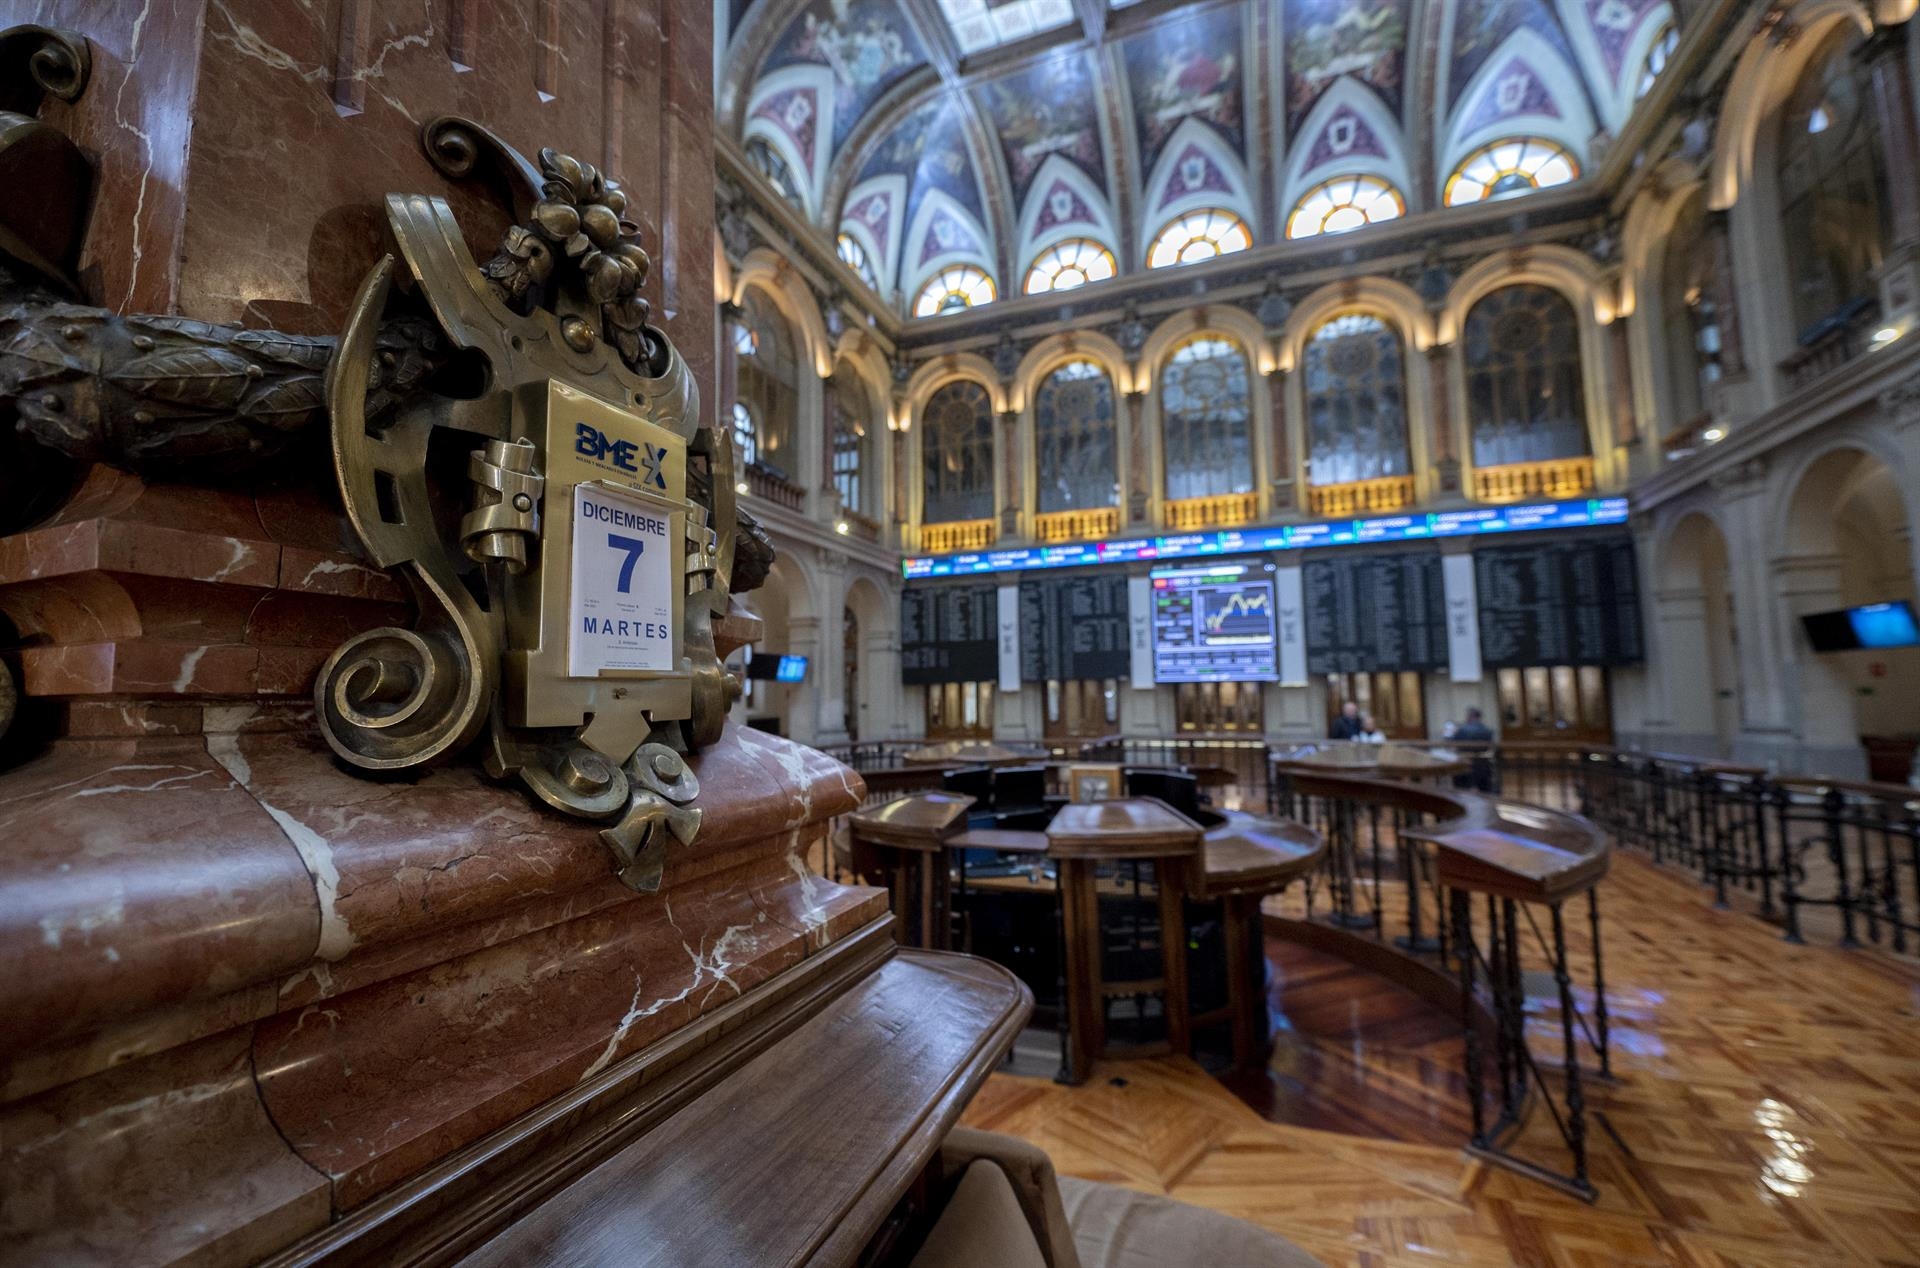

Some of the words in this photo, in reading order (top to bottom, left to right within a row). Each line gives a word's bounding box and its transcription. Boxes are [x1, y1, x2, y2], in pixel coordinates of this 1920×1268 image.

[583, 501, 666, 537] DICIEMBRE
[607, 533, 644, 594] 7
[583, 616, 668, 640] MARTES
